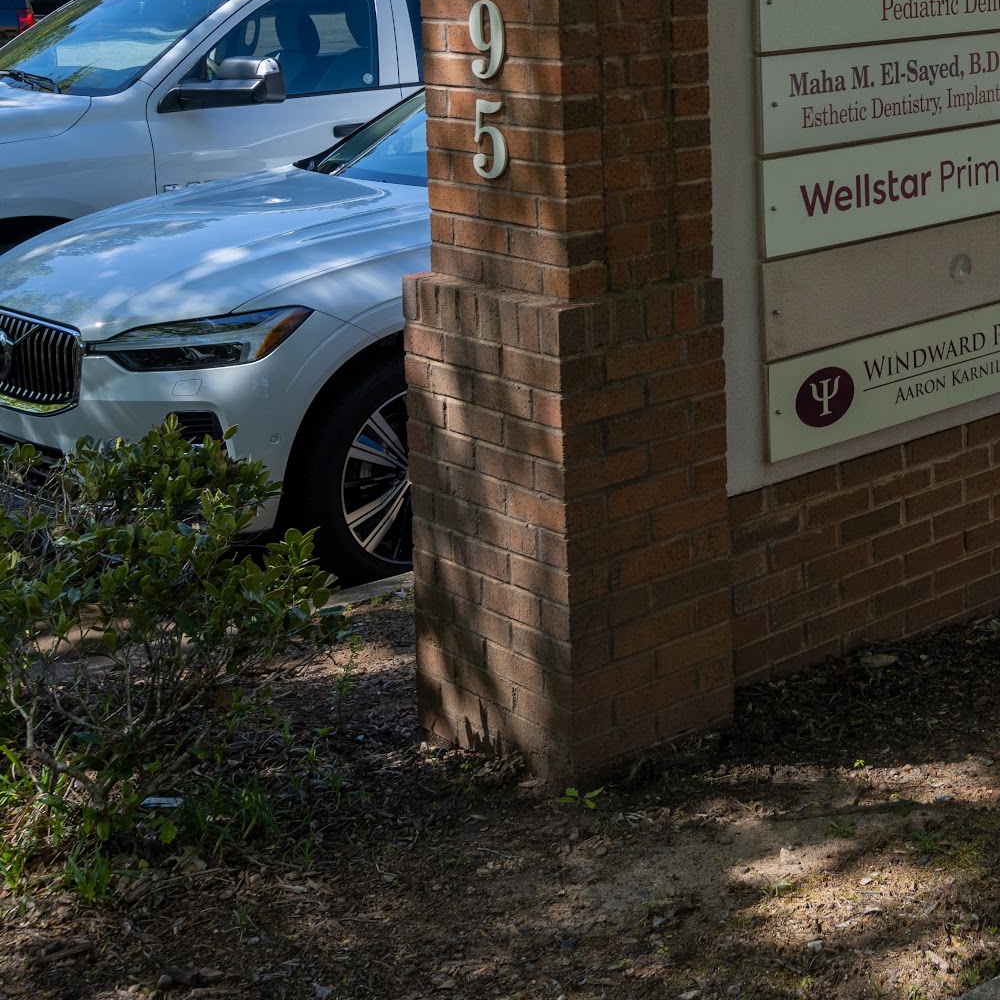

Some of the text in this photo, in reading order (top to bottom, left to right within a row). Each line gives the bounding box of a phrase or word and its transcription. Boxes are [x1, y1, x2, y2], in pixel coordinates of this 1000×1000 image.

[789, 70, 846, 97] Maha
[851, 65, 874, 89] M.
[880, 55, 964, 86] El-Sayed,
[802, 101, 866, 128] Esthetic
[871, 94, 941, 119] Dentistry,
[800, 171, 931, 217] Wellstar
[864, 332, 986, 382] WINDWARD
[896, 376, 945, 403] AARON
